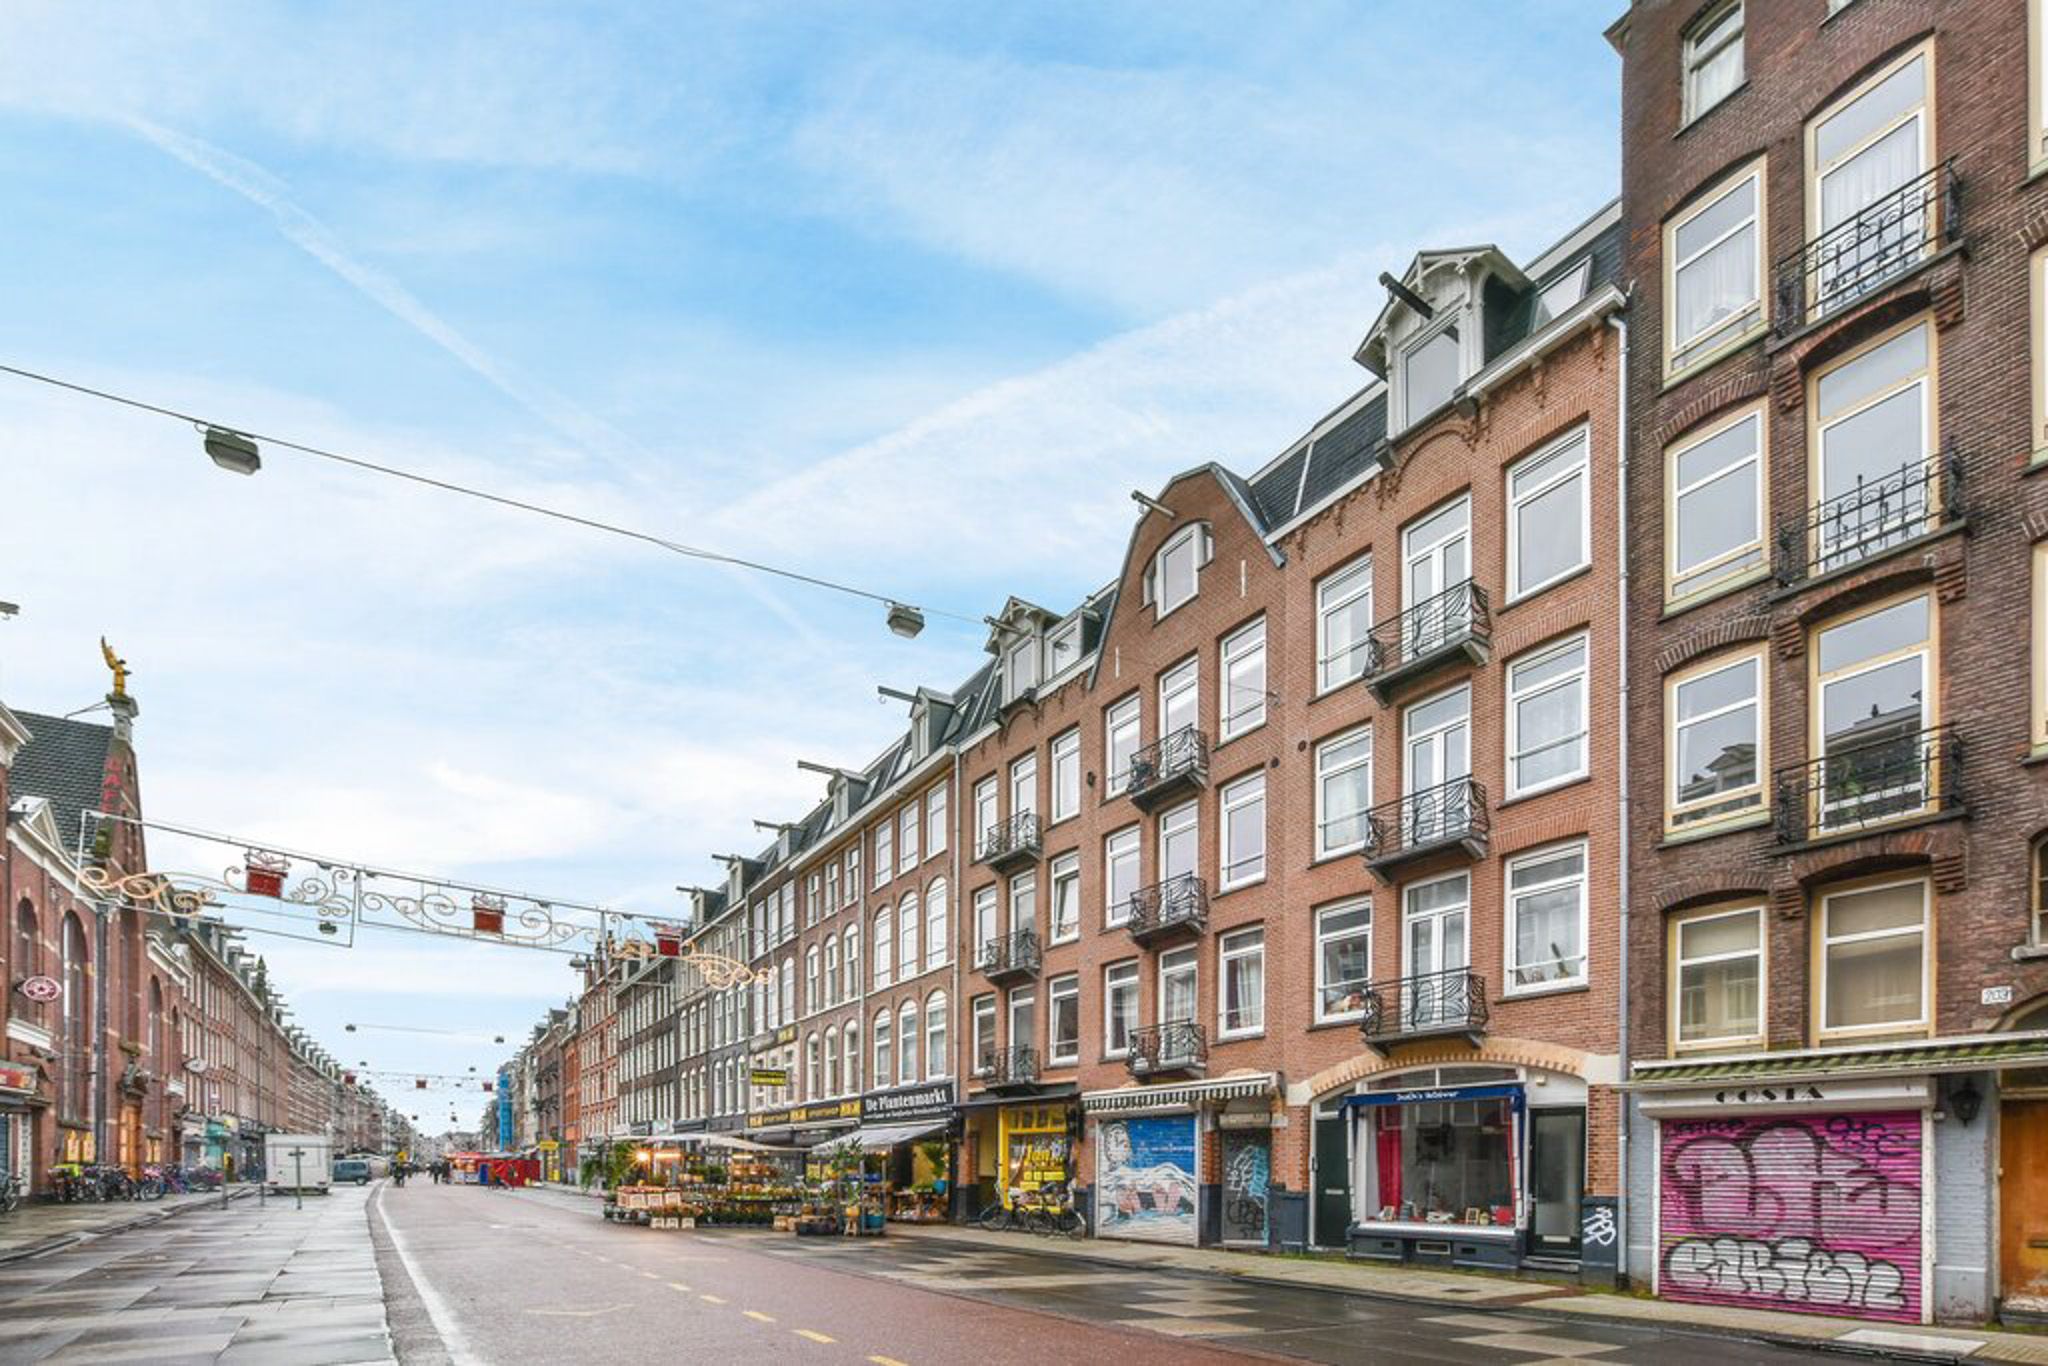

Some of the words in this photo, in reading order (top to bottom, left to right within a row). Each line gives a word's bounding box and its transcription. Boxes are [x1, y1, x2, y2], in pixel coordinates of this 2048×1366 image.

[865, 1098, 878, 1112] De
[879, 1088, 947, 1110] Plantenmarkt
[1714, 1085, 1824, 1104] COSTA
